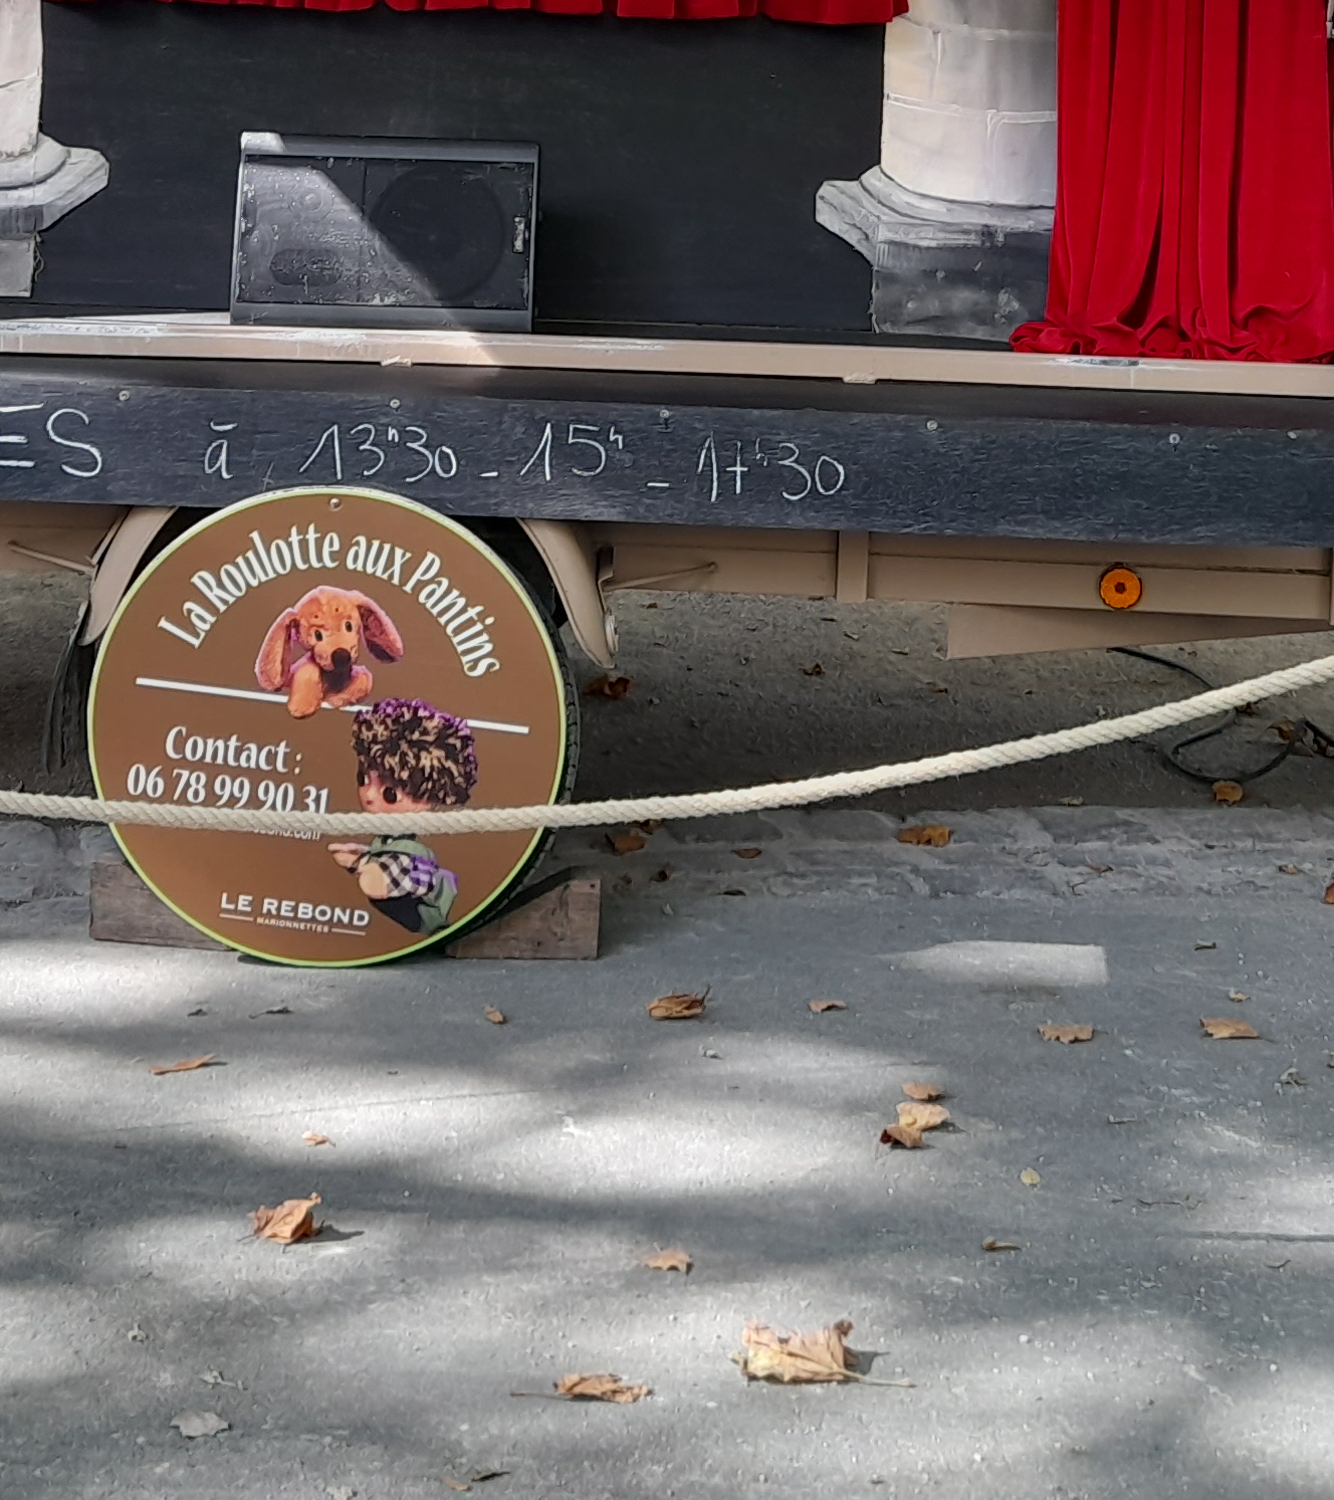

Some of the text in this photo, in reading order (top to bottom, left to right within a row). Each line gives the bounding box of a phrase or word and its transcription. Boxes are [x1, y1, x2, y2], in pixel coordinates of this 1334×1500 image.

[157, 522, 500, 678] La Roulotte aux Pantins
[126, 763, 330, 815] 06 78 99 90 31
[221, 892, 370, 927] LE REBOND
[257, 916, 330, 933] MARIONNETTES
